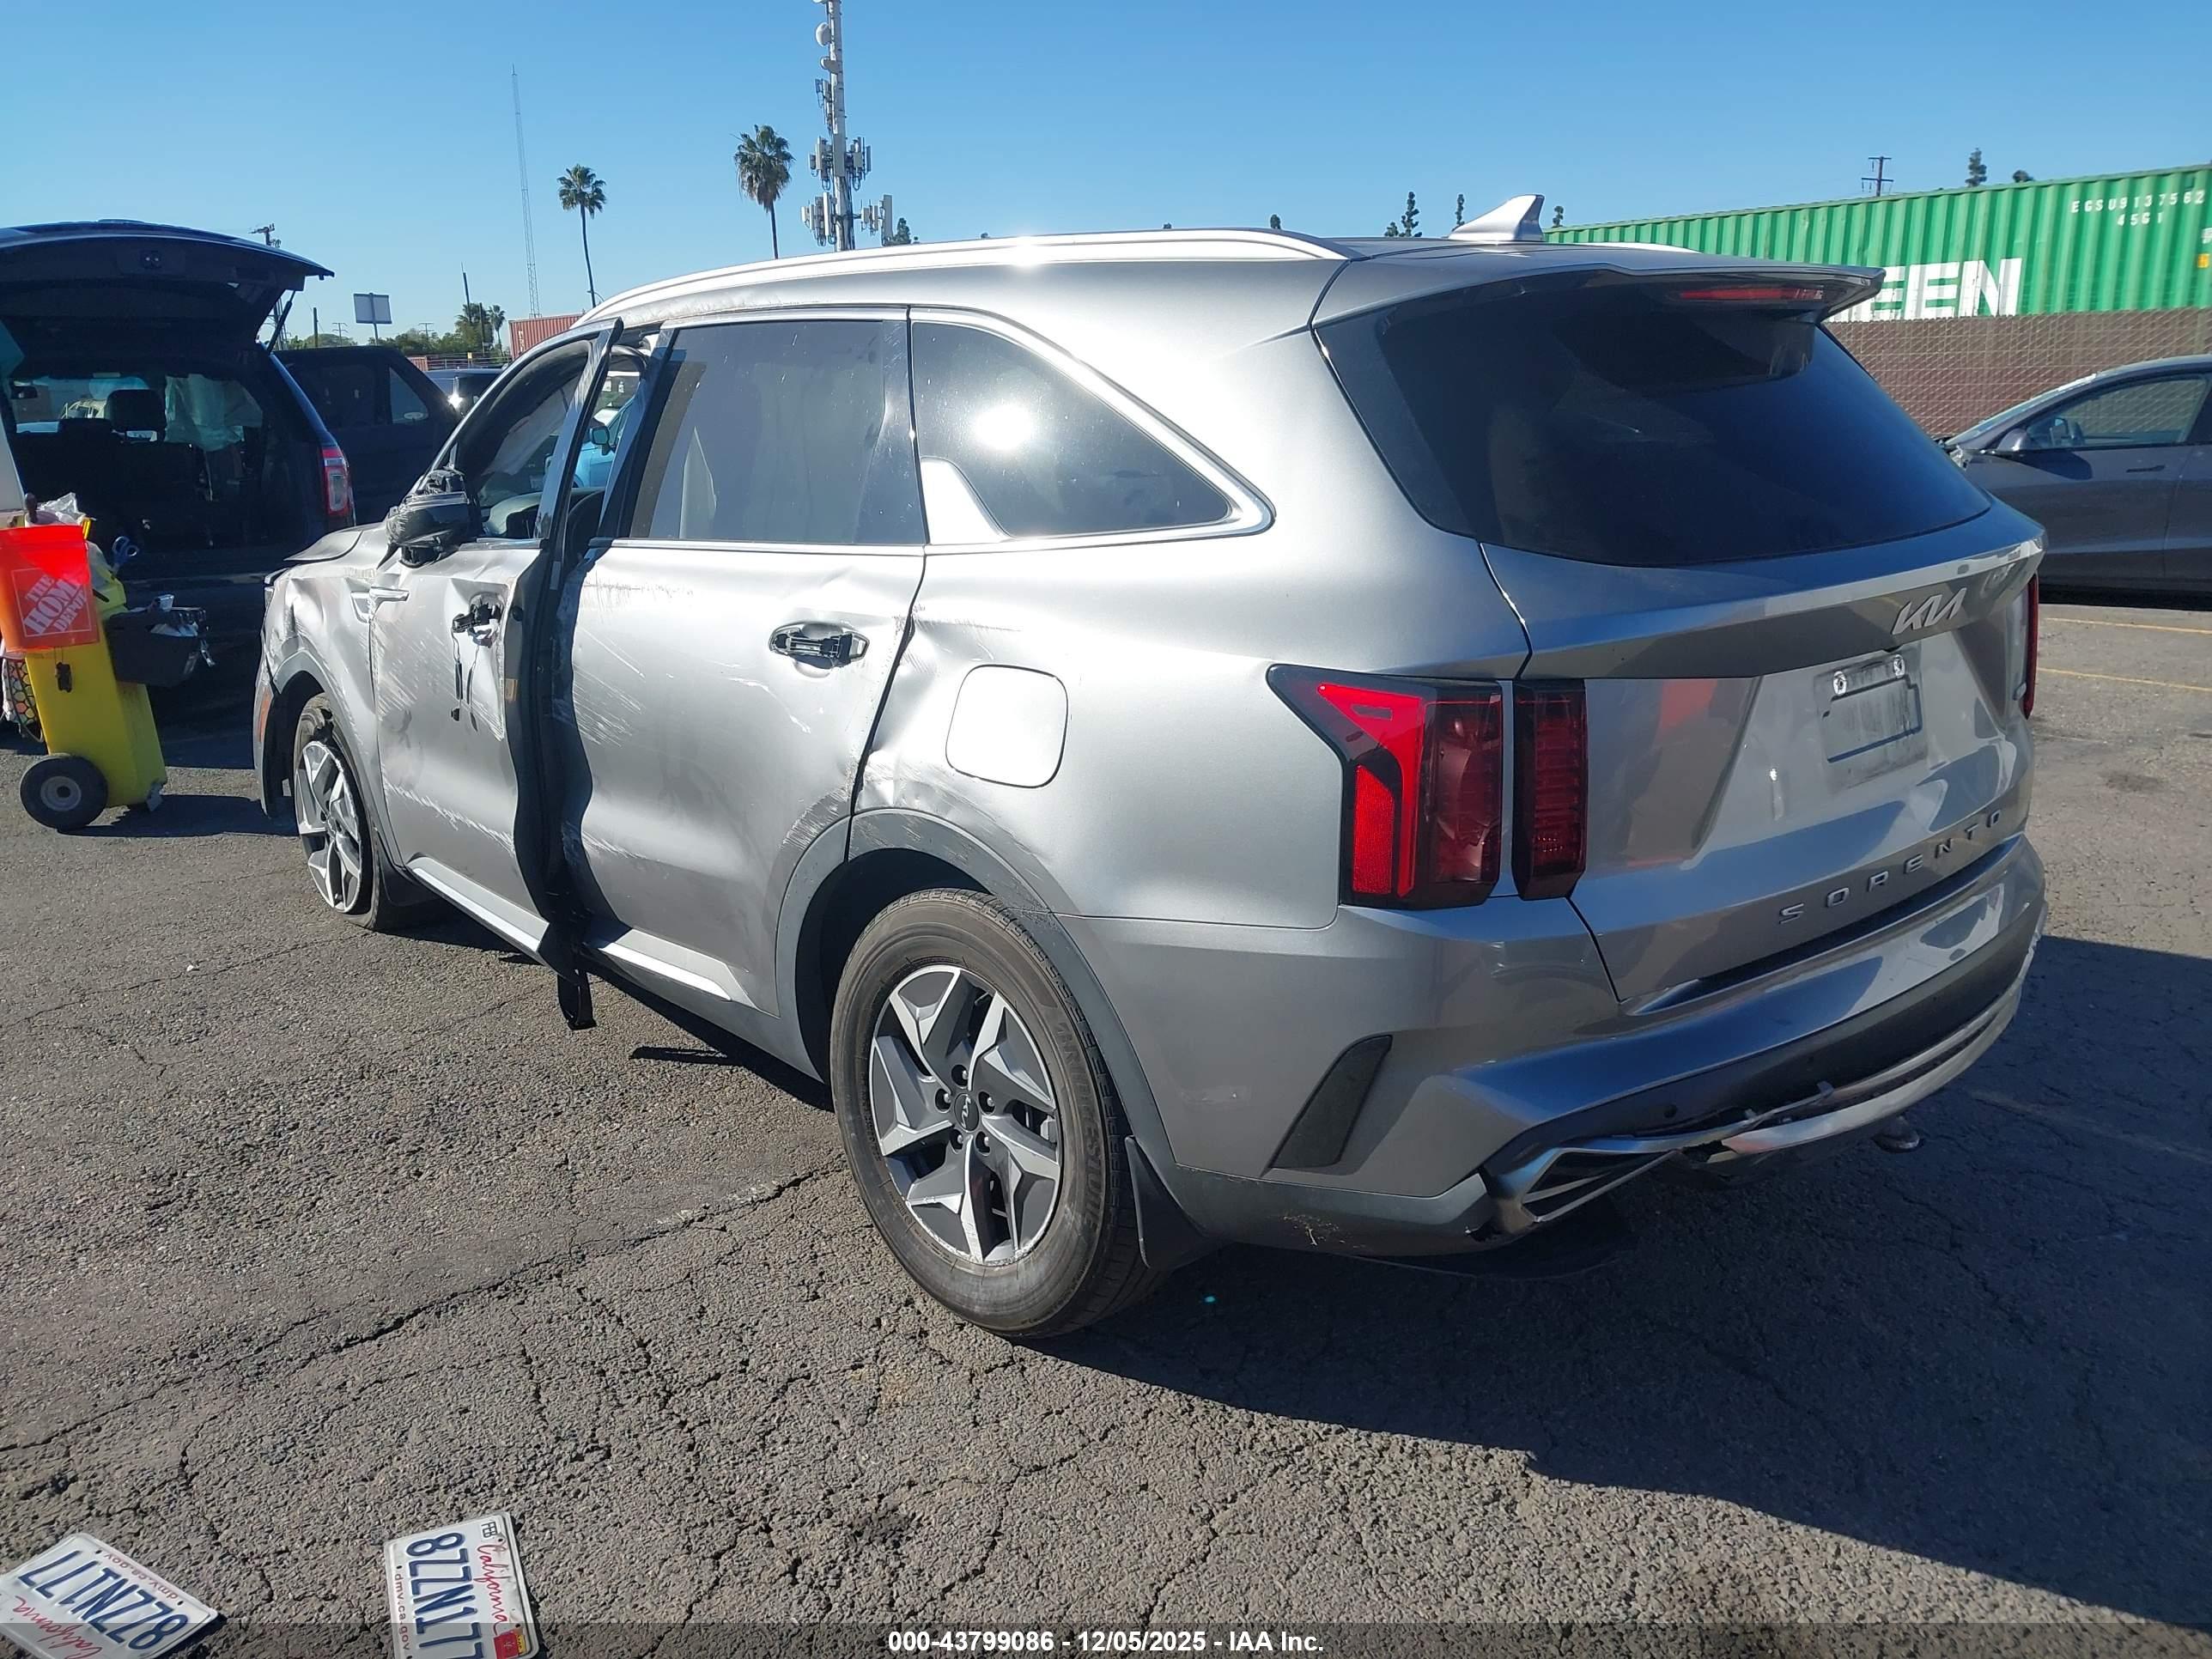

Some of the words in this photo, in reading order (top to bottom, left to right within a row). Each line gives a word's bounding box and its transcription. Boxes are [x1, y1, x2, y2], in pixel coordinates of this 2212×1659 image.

[1829, 258, 2022, 323] EEN
[26, 574, 55, 601] THE
[1778, 809, 2002, 925] SORENTO
[481, 1521, 498, 1539] FEB
[18, 1550, 188, 1650] 8ZZN177
[105, 1553, 179, 1600] dmv.ca.gov
[394, 1573, 411, 1651] dmv.ca.gov
[473, 1544, 511, 1636] California
